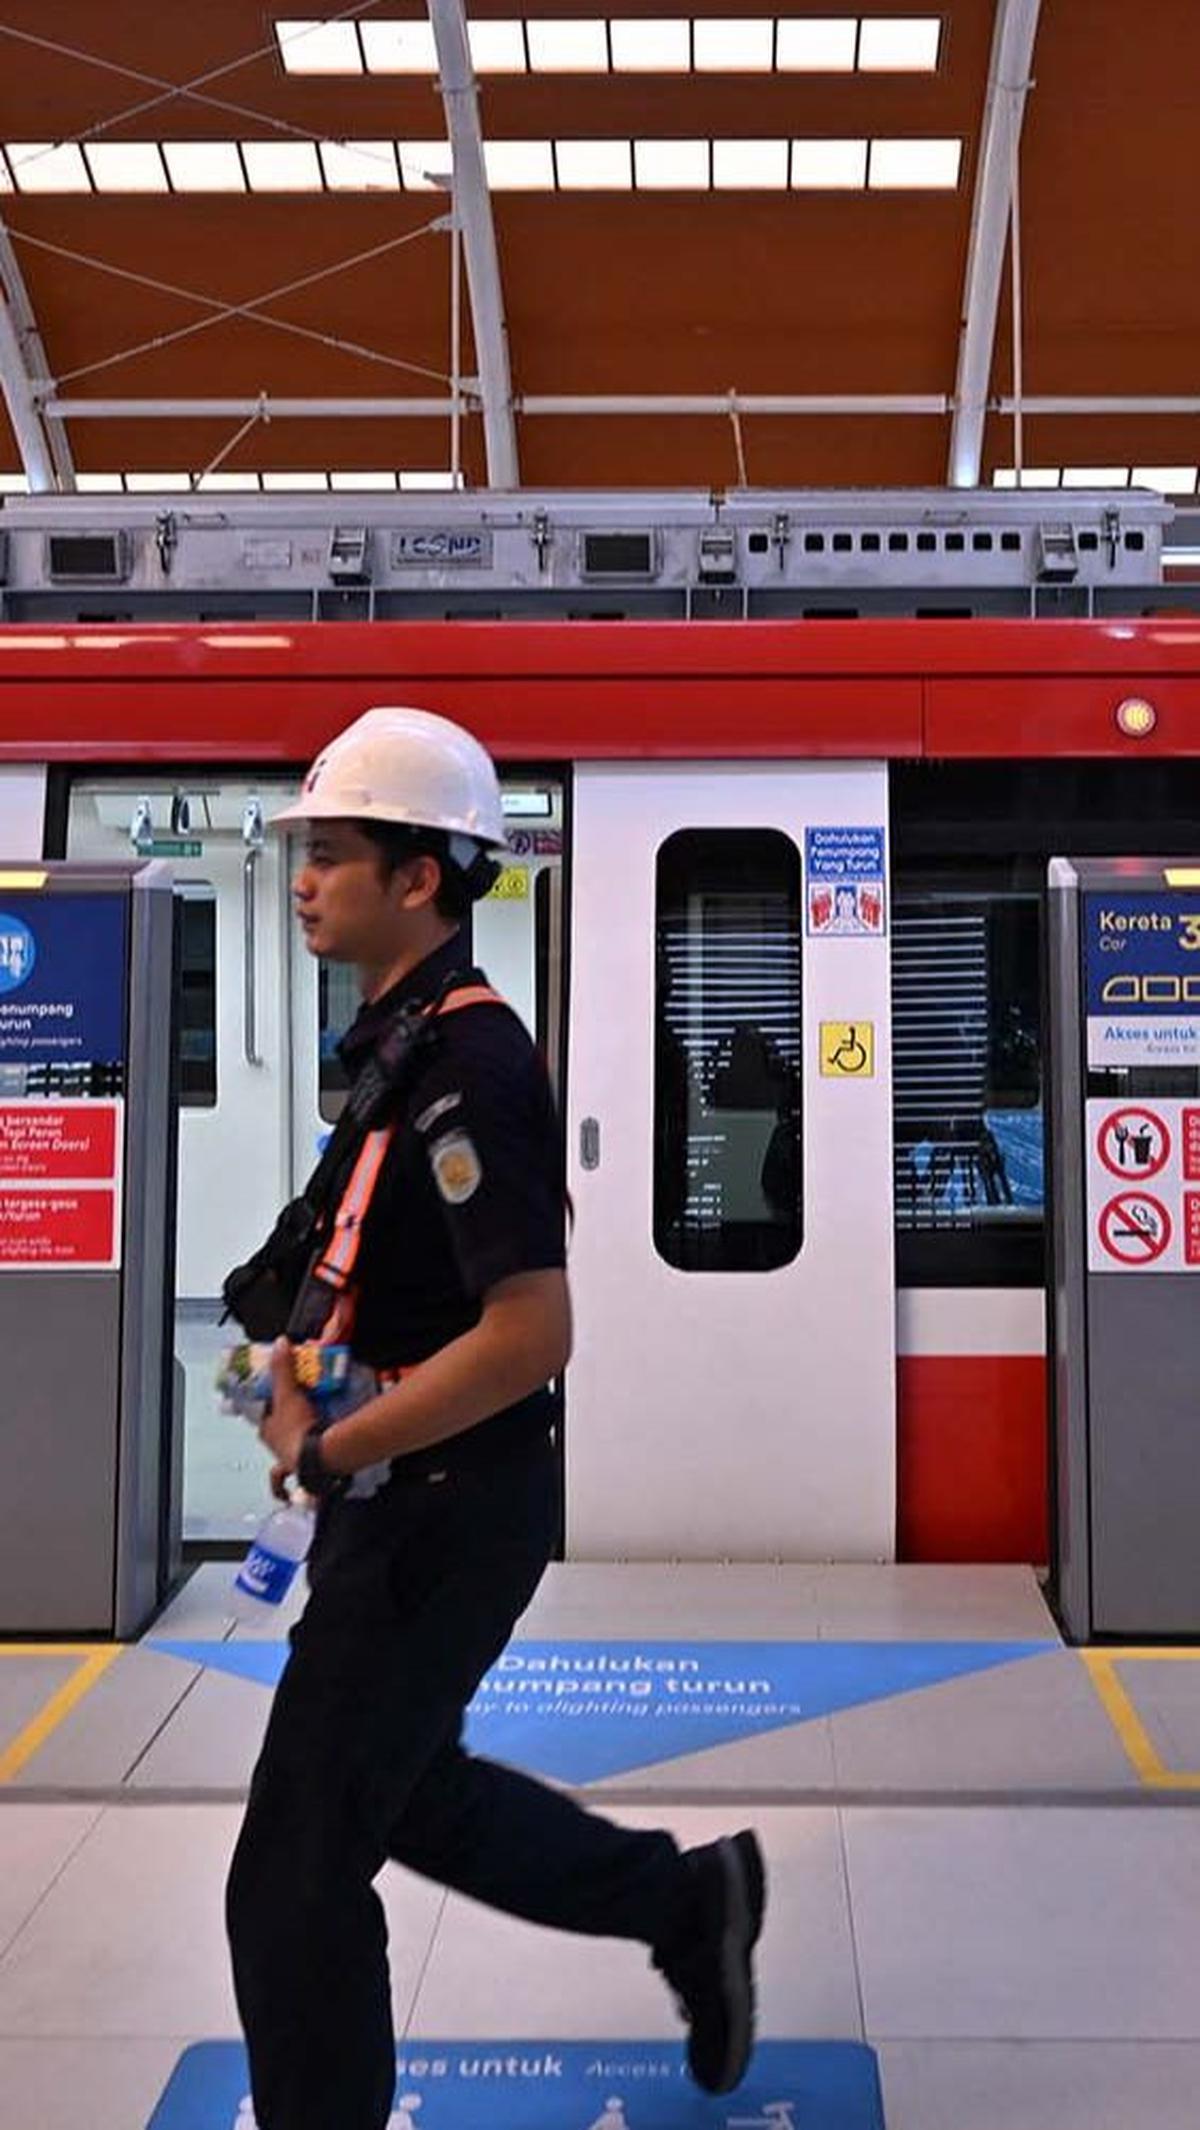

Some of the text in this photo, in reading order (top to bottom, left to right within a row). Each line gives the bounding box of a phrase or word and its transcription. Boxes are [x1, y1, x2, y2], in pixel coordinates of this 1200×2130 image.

[814, 860, 877, 873] Yang Turun
[1100, 911, 1172, 931] Kereta
[1100, 936, 1127, 951] Car
[1105, 1026, 1196, 1041] Akses untuk
[498, 1655, 699, 1671] Dahulukan
[664, 1678, 771, 1694] turun
[506, 1701, 529, 1713] to
[536, 1700, 648, 1716] alighting
[655, 1703, 801, 1716] passengers
[459, 2055, 563, 2078] untuk
